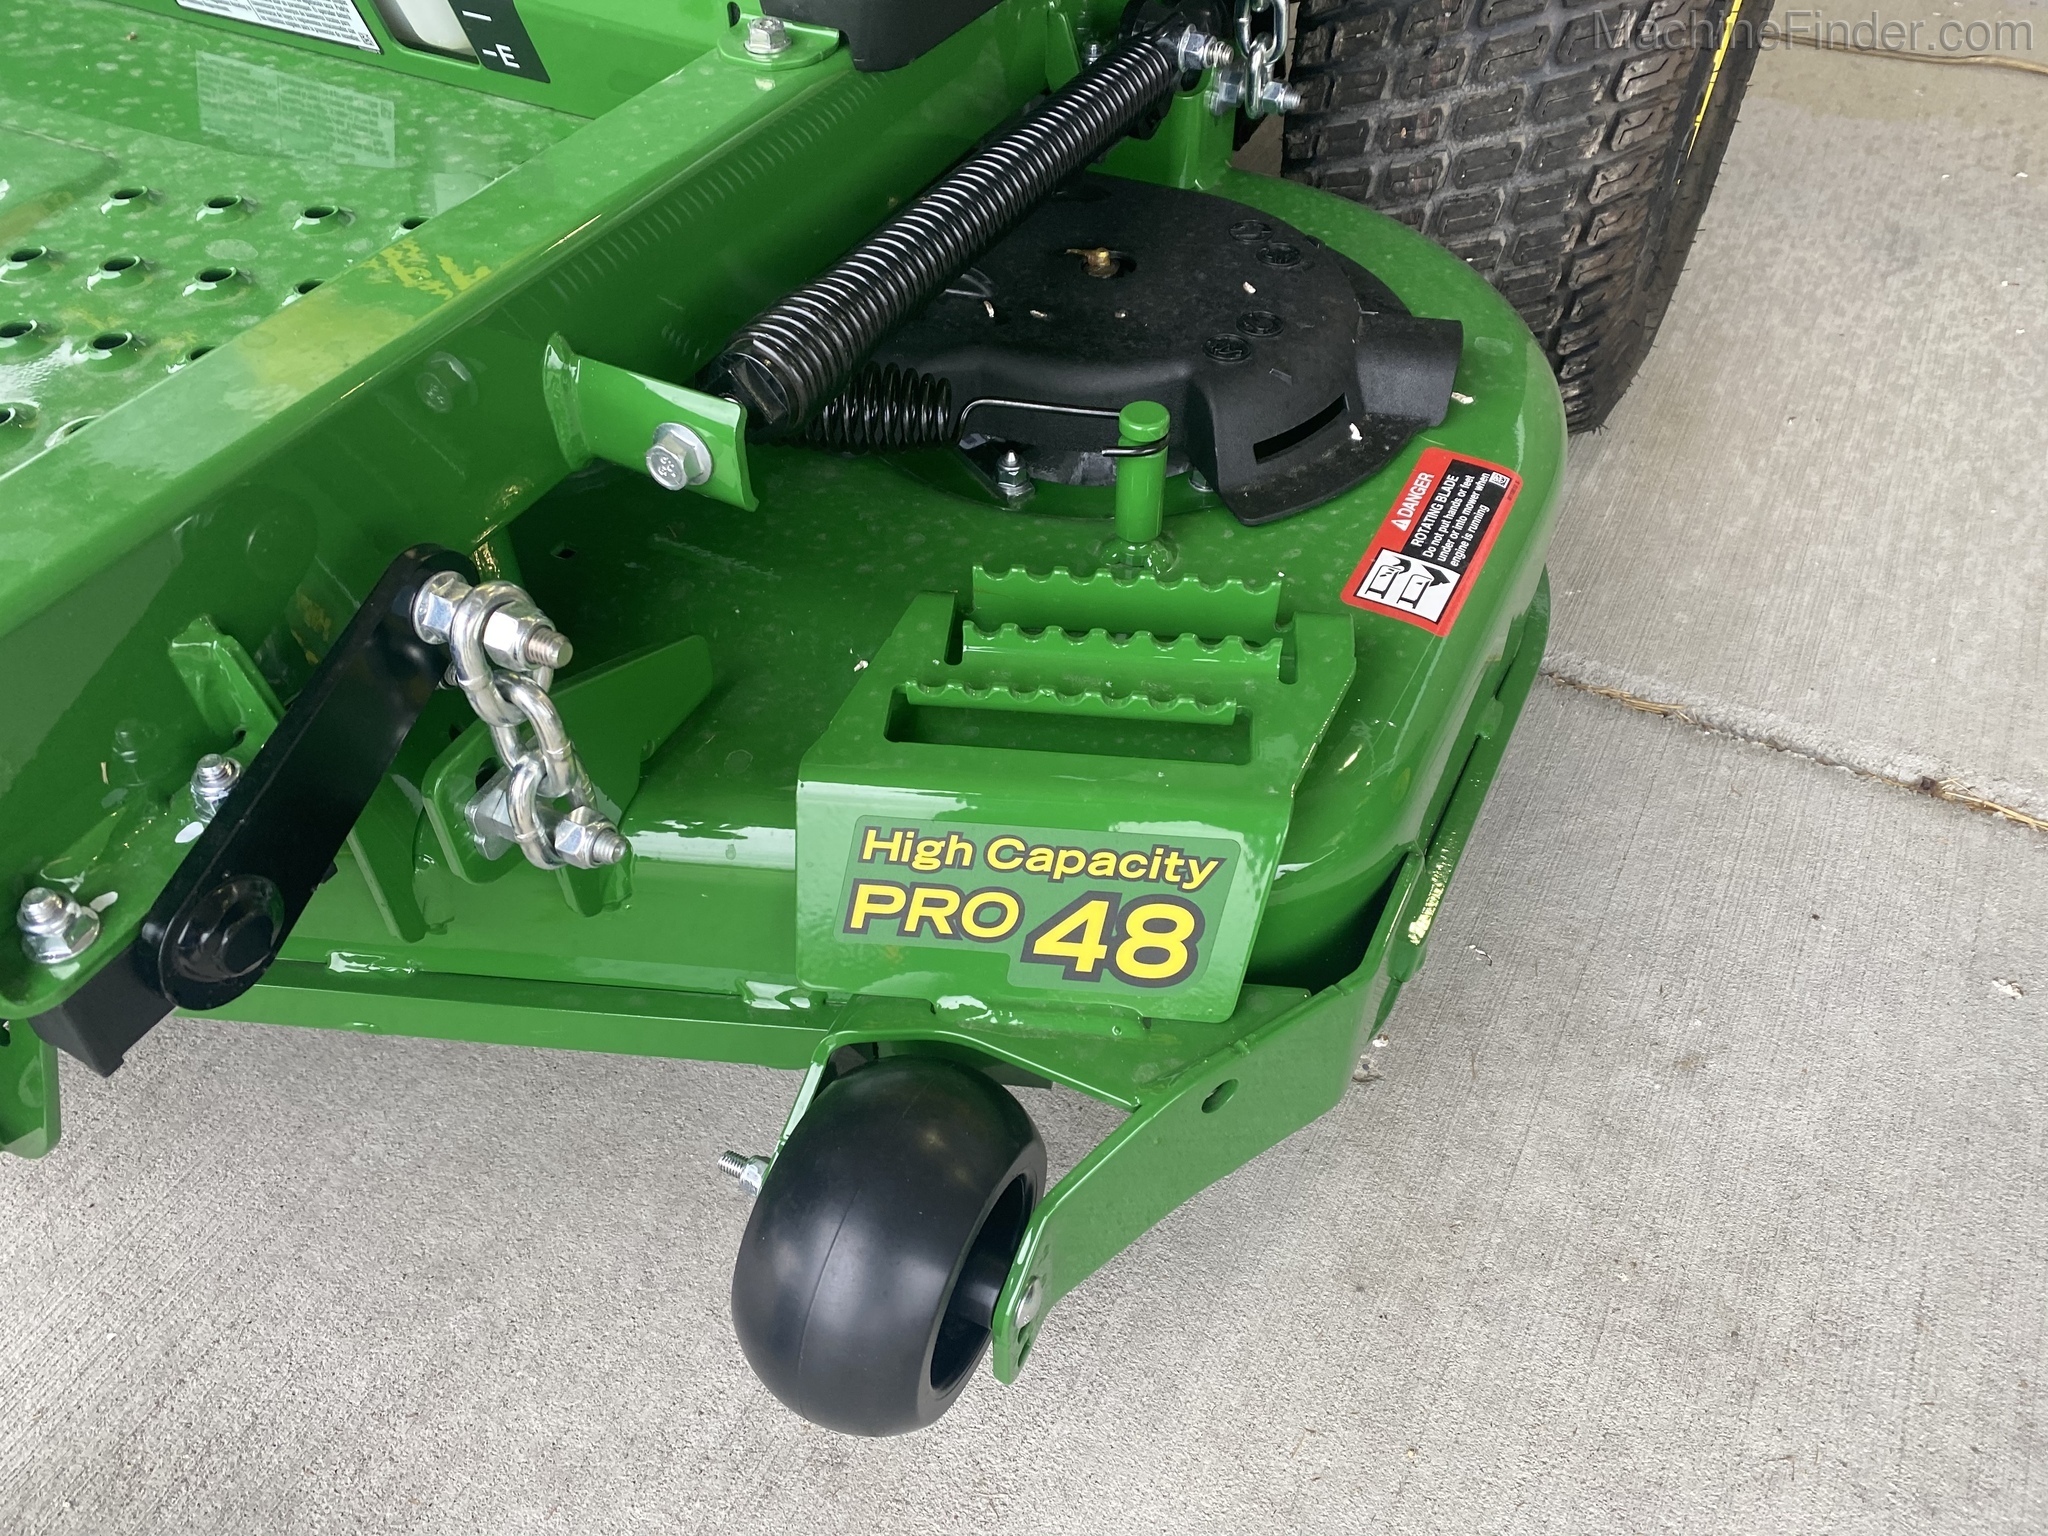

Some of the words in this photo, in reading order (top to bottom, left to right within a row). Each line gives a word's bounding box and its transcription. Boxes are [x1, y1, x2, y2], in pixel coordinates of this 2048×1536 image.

[495, 43, 520, 68] E
[1458, 488, 1468, 498] or
[1460, 475, 1475, 489] feet
[1475, 472, 1491, 491] when
[1397, 472, 1435, 518] DANGER
[1462, 491, 1480, 516] mower
[1410, 503, 1444, 547] ROTATING
[1435, 474, 1459, 503] BLADE
[1443, 497, 1463, 520] hands
[1438, 519, 1452, 534] put
[1452, 515, 1468, 531] into
[1431, 532, 1444, 546] not
[1450, 530, 1460, 540] or
[1450, 540, 1469, 567] engine
[1461, 532, 1474, 541] is
[1468, 504, 1490, 533] running
[1422, 545, 1437, 558] Do
[1437, 539, 1455, 562] under
[858, 827, 977, 874] High
[984, 835, 1225, 891] Capacity
[843, 879, 1025, 942] PRO
[1021, 891, 1205, 987] 48
